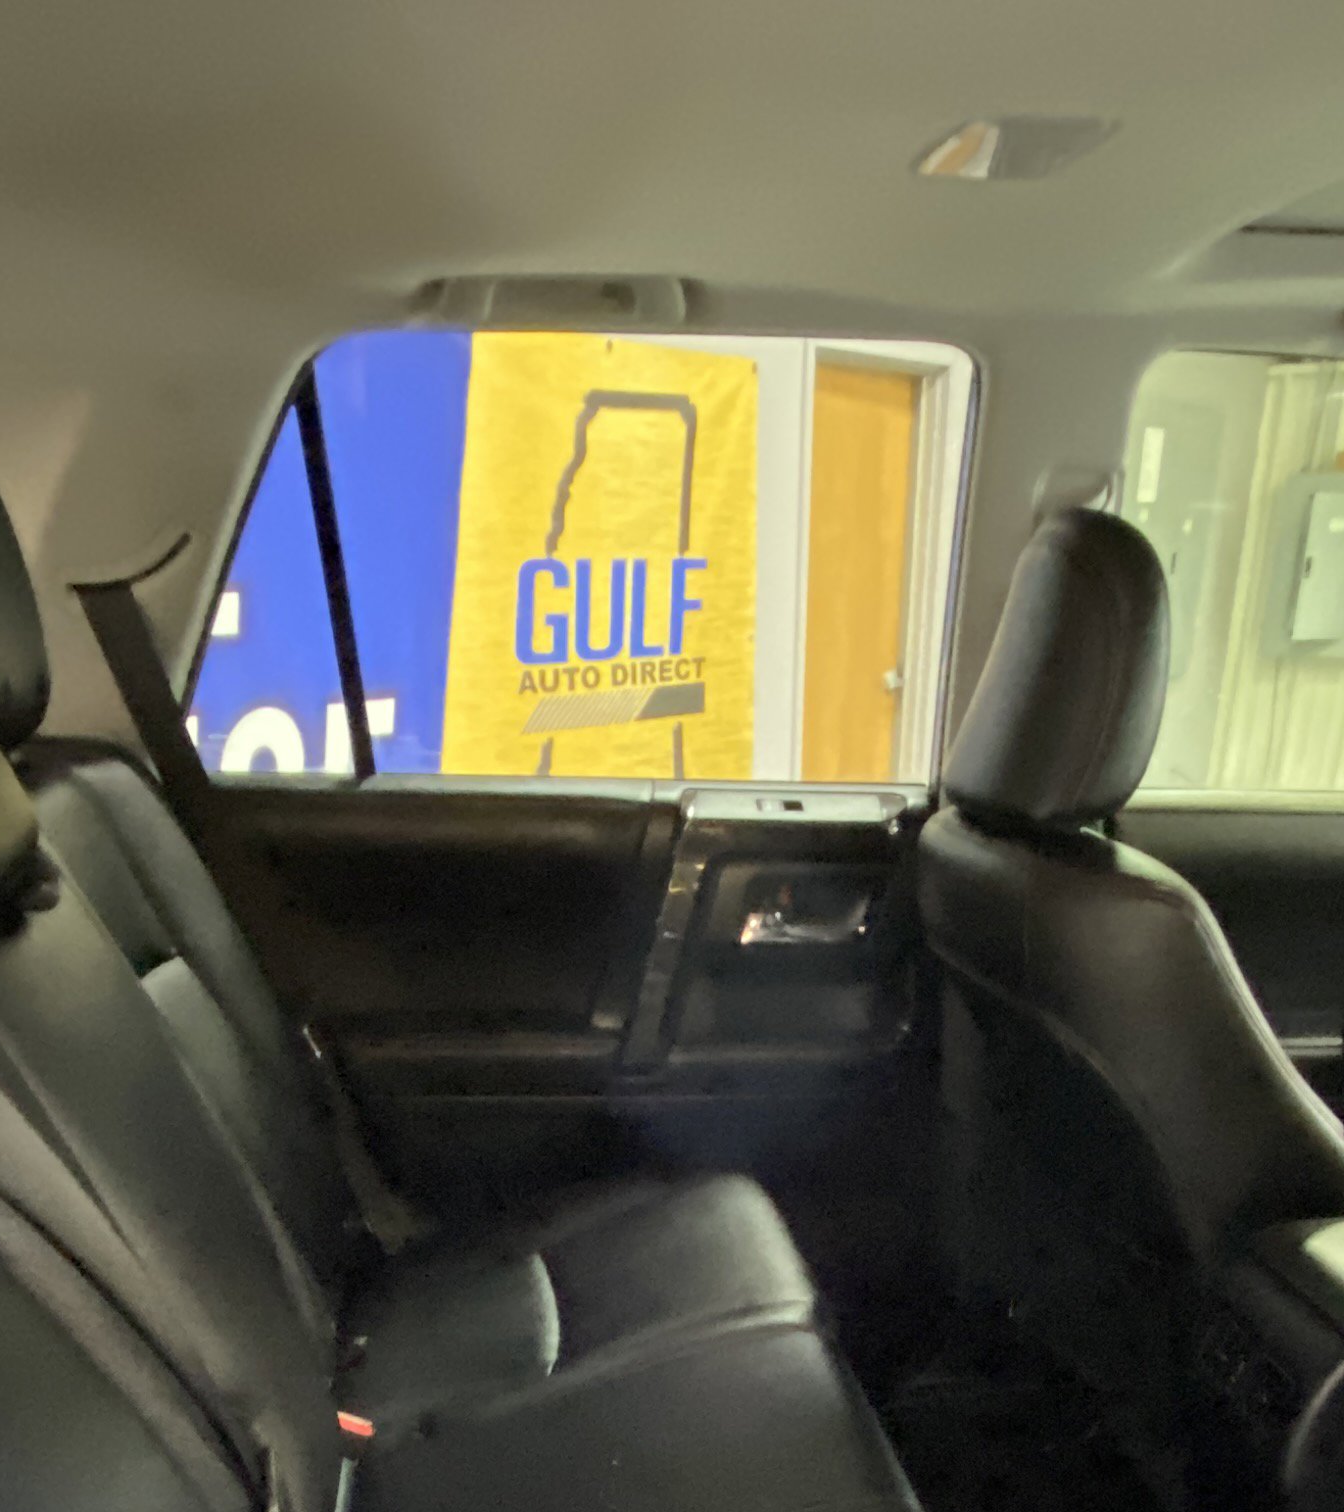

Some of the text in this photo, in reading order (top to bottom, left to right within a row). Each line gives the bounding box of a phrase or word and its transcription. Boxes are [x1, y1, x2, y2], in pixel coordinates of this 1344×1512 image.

[515, 557, 707, 665] GULF
[518, 656, 706, 696] AUTO DIRECT
